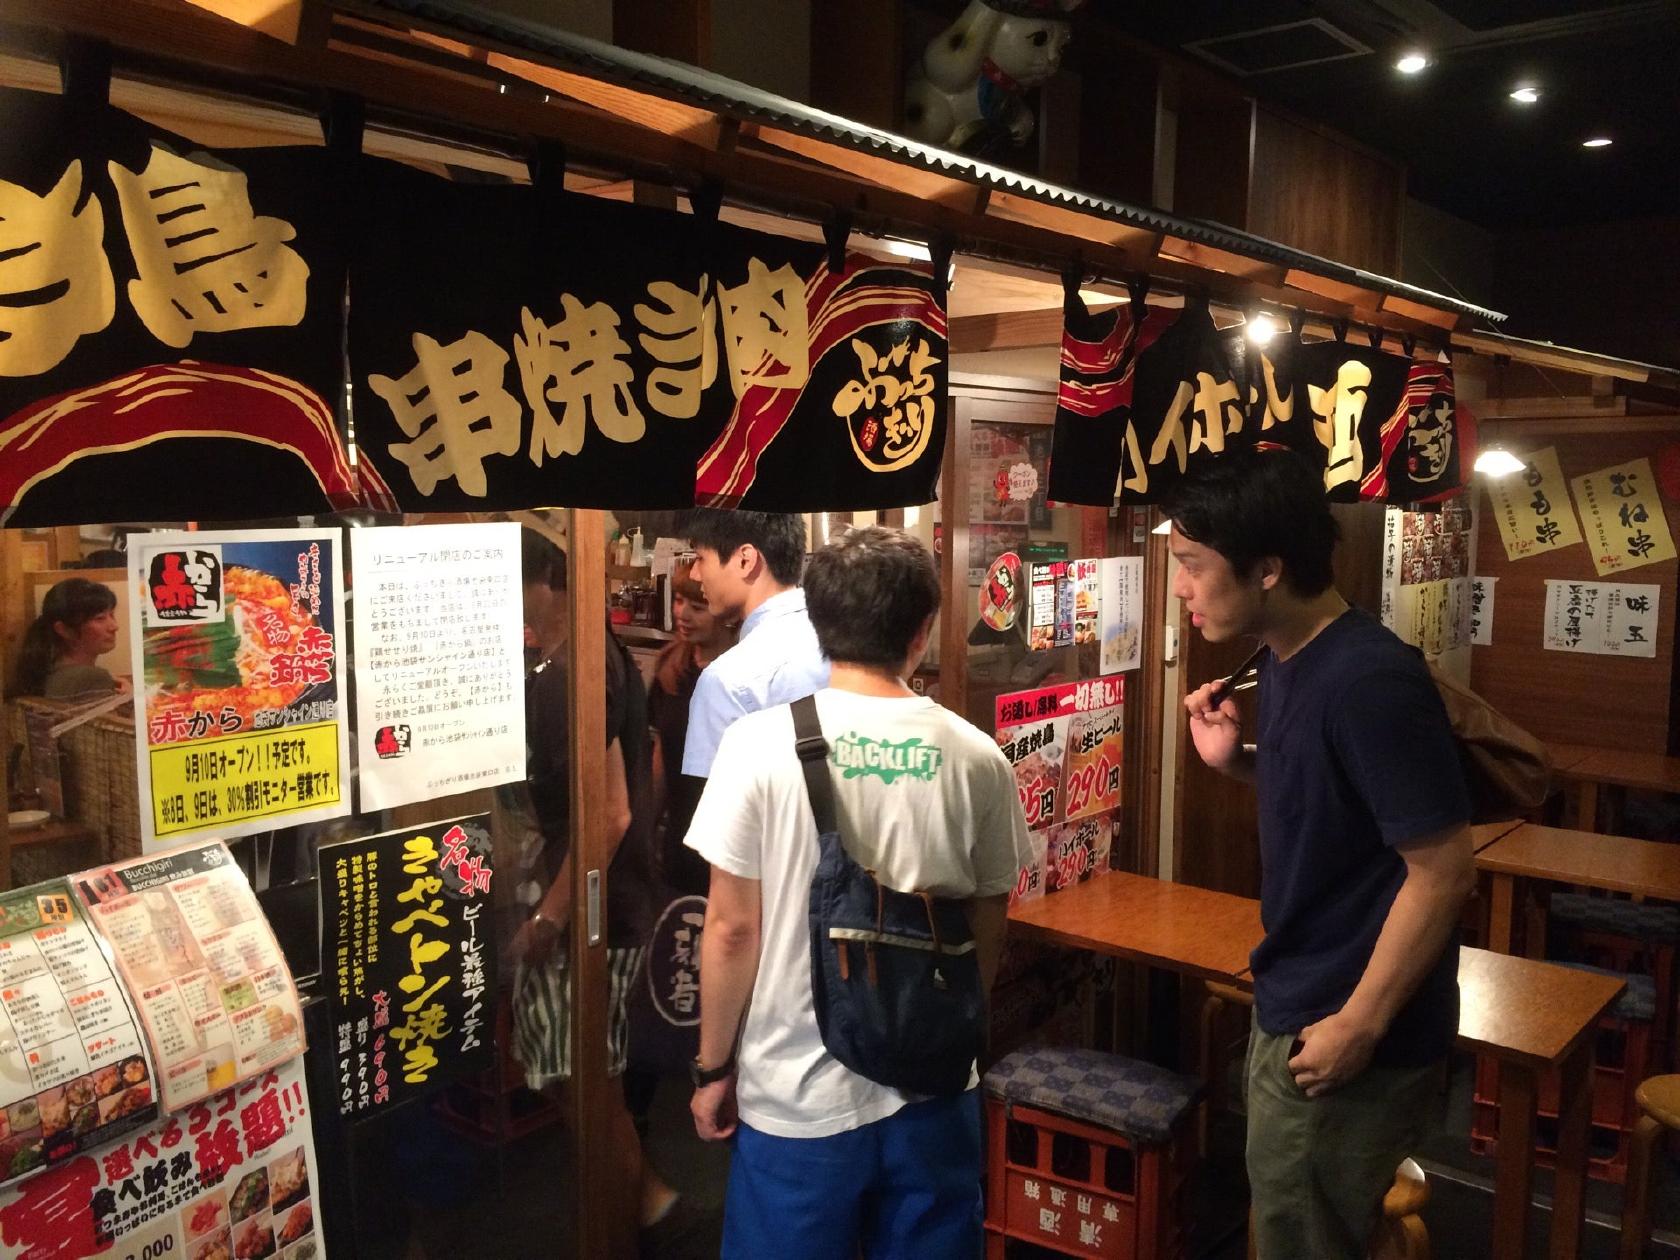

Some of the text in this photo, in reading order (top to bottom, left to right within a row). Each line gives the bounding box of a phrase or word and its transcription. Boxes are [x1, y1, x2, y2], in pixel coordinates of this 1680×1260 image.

[1610, 472, 1655, 558] むね串
[262, 613, 292, 645] 名物
[151, 707, 243, 744] 赤から
[1081, 716, 1121, 754] 生ビール
[836, 740, 940, 774] BACKLIFT
[1019, 778, 1055, 823] 5円
[1067, 756, 1120, 818] 290円
[1057, 848, 1098, 889] 290円
